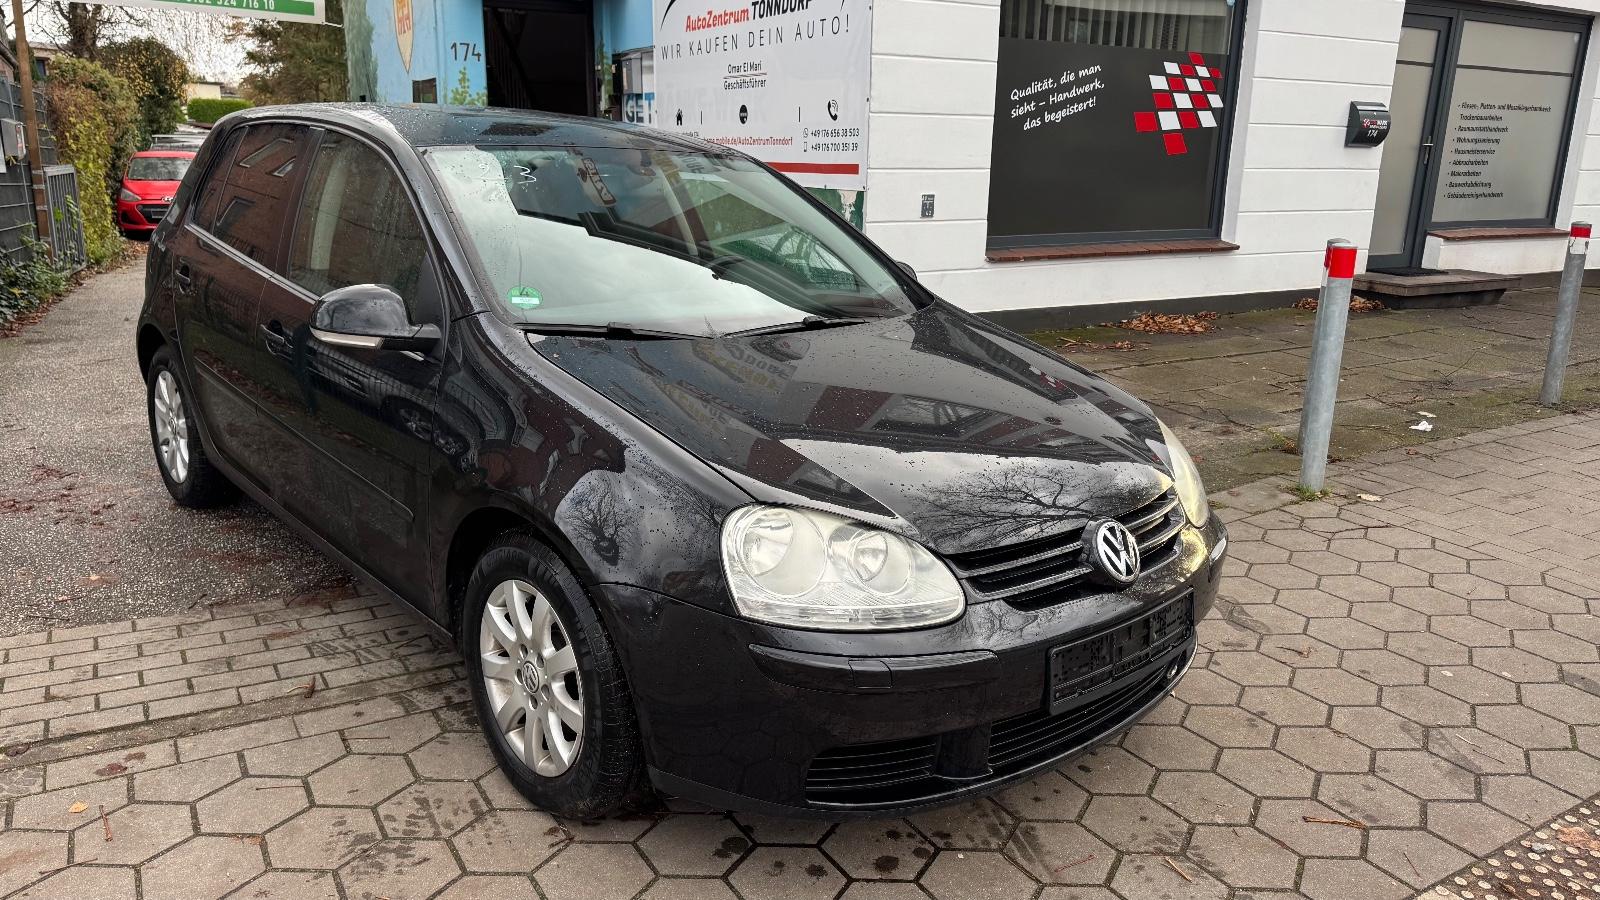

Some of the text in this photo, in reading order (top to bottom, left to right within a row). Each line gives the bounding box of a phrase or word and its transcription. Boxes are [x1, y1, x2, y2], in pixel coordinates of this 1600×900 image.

[685, 8, 750, 33] AutoZentrum
[450, 41, 482, 62] 174
[661, 14, 849, 60] WIR KAUFEN DEIN AUTO!
[727, 64, 742, 74] Omar
[749, 60, 762, 72] Mari
[723, 78, 767, 90] Geschäftsführer
[1010, 64, 1102, 101] Qualität, die man
[1011, 100, 1036, 118] sieht
[1049, 79, 1105, 105] Handwerk,
[1023, 96, 1096, 131] das begeistert!
